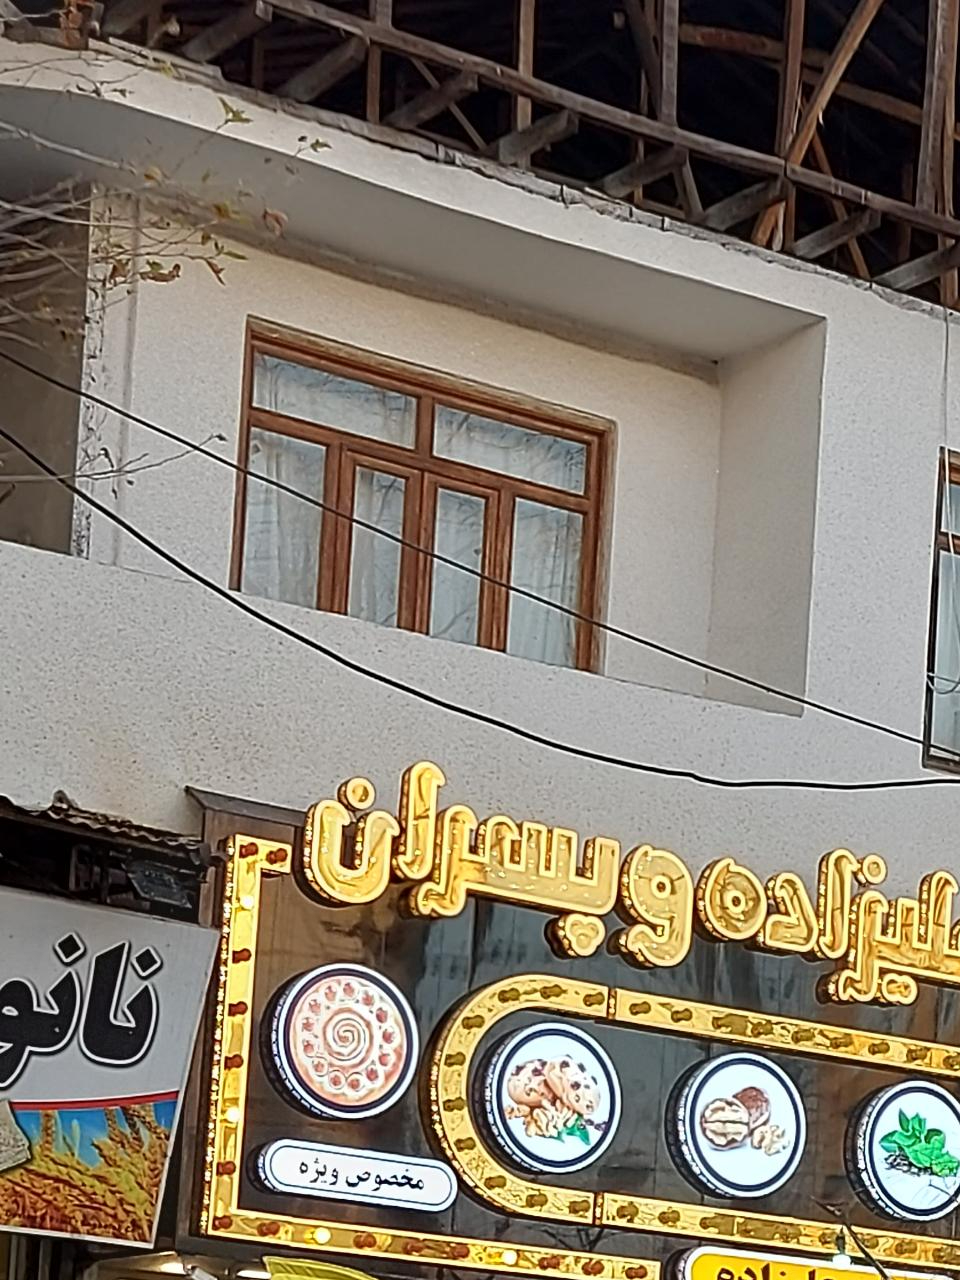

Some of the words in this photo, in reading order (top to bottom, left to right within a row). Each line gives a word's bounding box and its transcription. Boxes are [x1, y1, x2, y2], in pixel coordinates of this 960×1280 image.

[305, 761, 620, 958] پسران
[617, 846, 694, 967] و
[299, 1158, 339, 1185] ویژه
[346, 1168, 424, 1191] مخصوص
